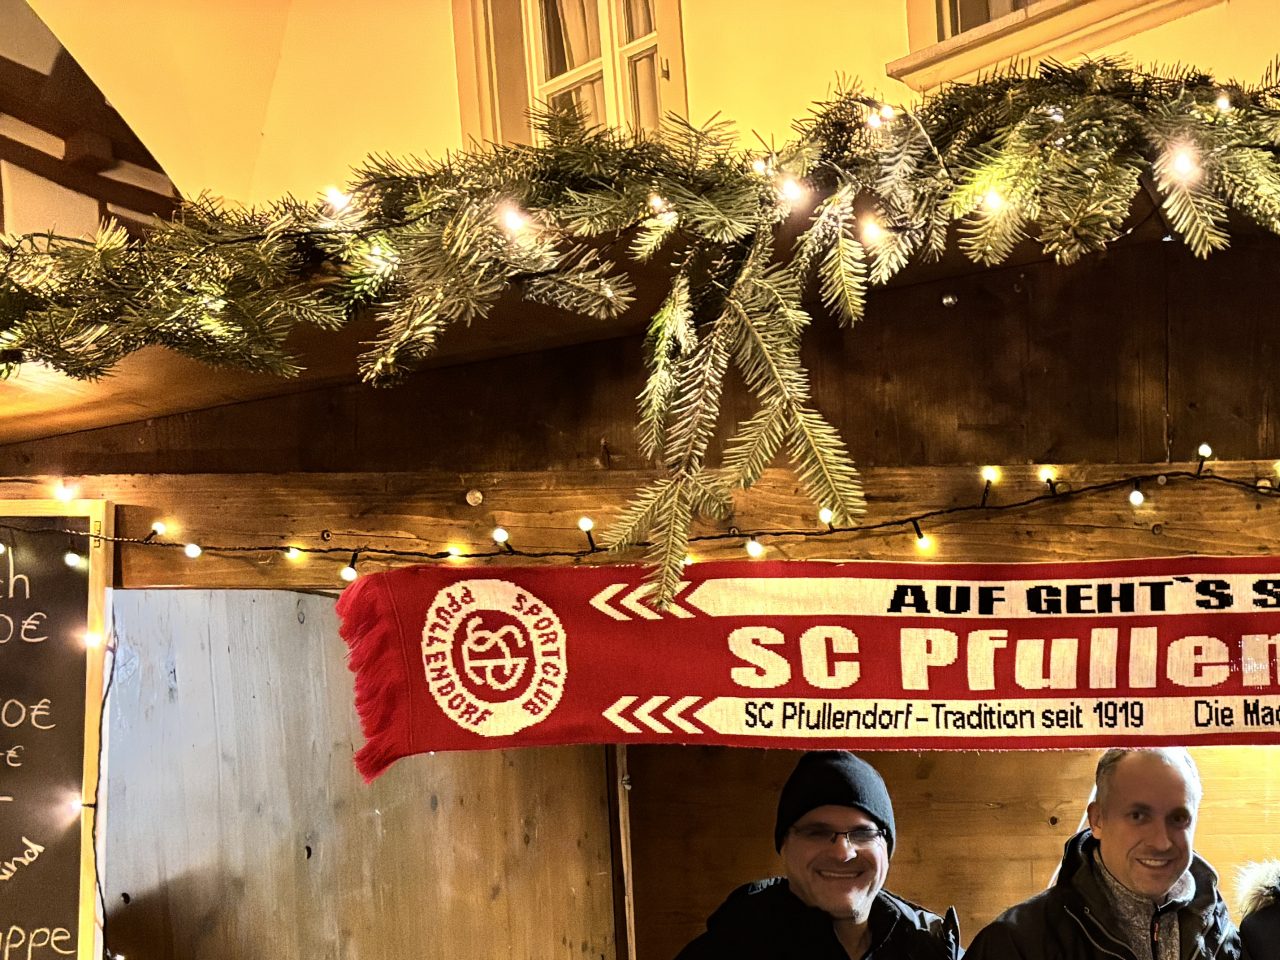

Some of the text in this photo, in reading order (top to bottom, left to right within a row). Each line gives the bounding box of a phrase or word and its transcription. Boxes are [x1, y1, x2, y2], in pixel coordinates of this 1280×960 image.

[887, 583, 1006, 616] AUF
[424, 586, 561, 726] SPORTCLUB PFULLENDORF
[728, 626, 861, 690] SC
[744, 701, 774, 728] SC
[1041, 701, 1083, 728] seit
[1093, 700, 1144, 728] 1919
[1194, 699, 1234, 728] Die
